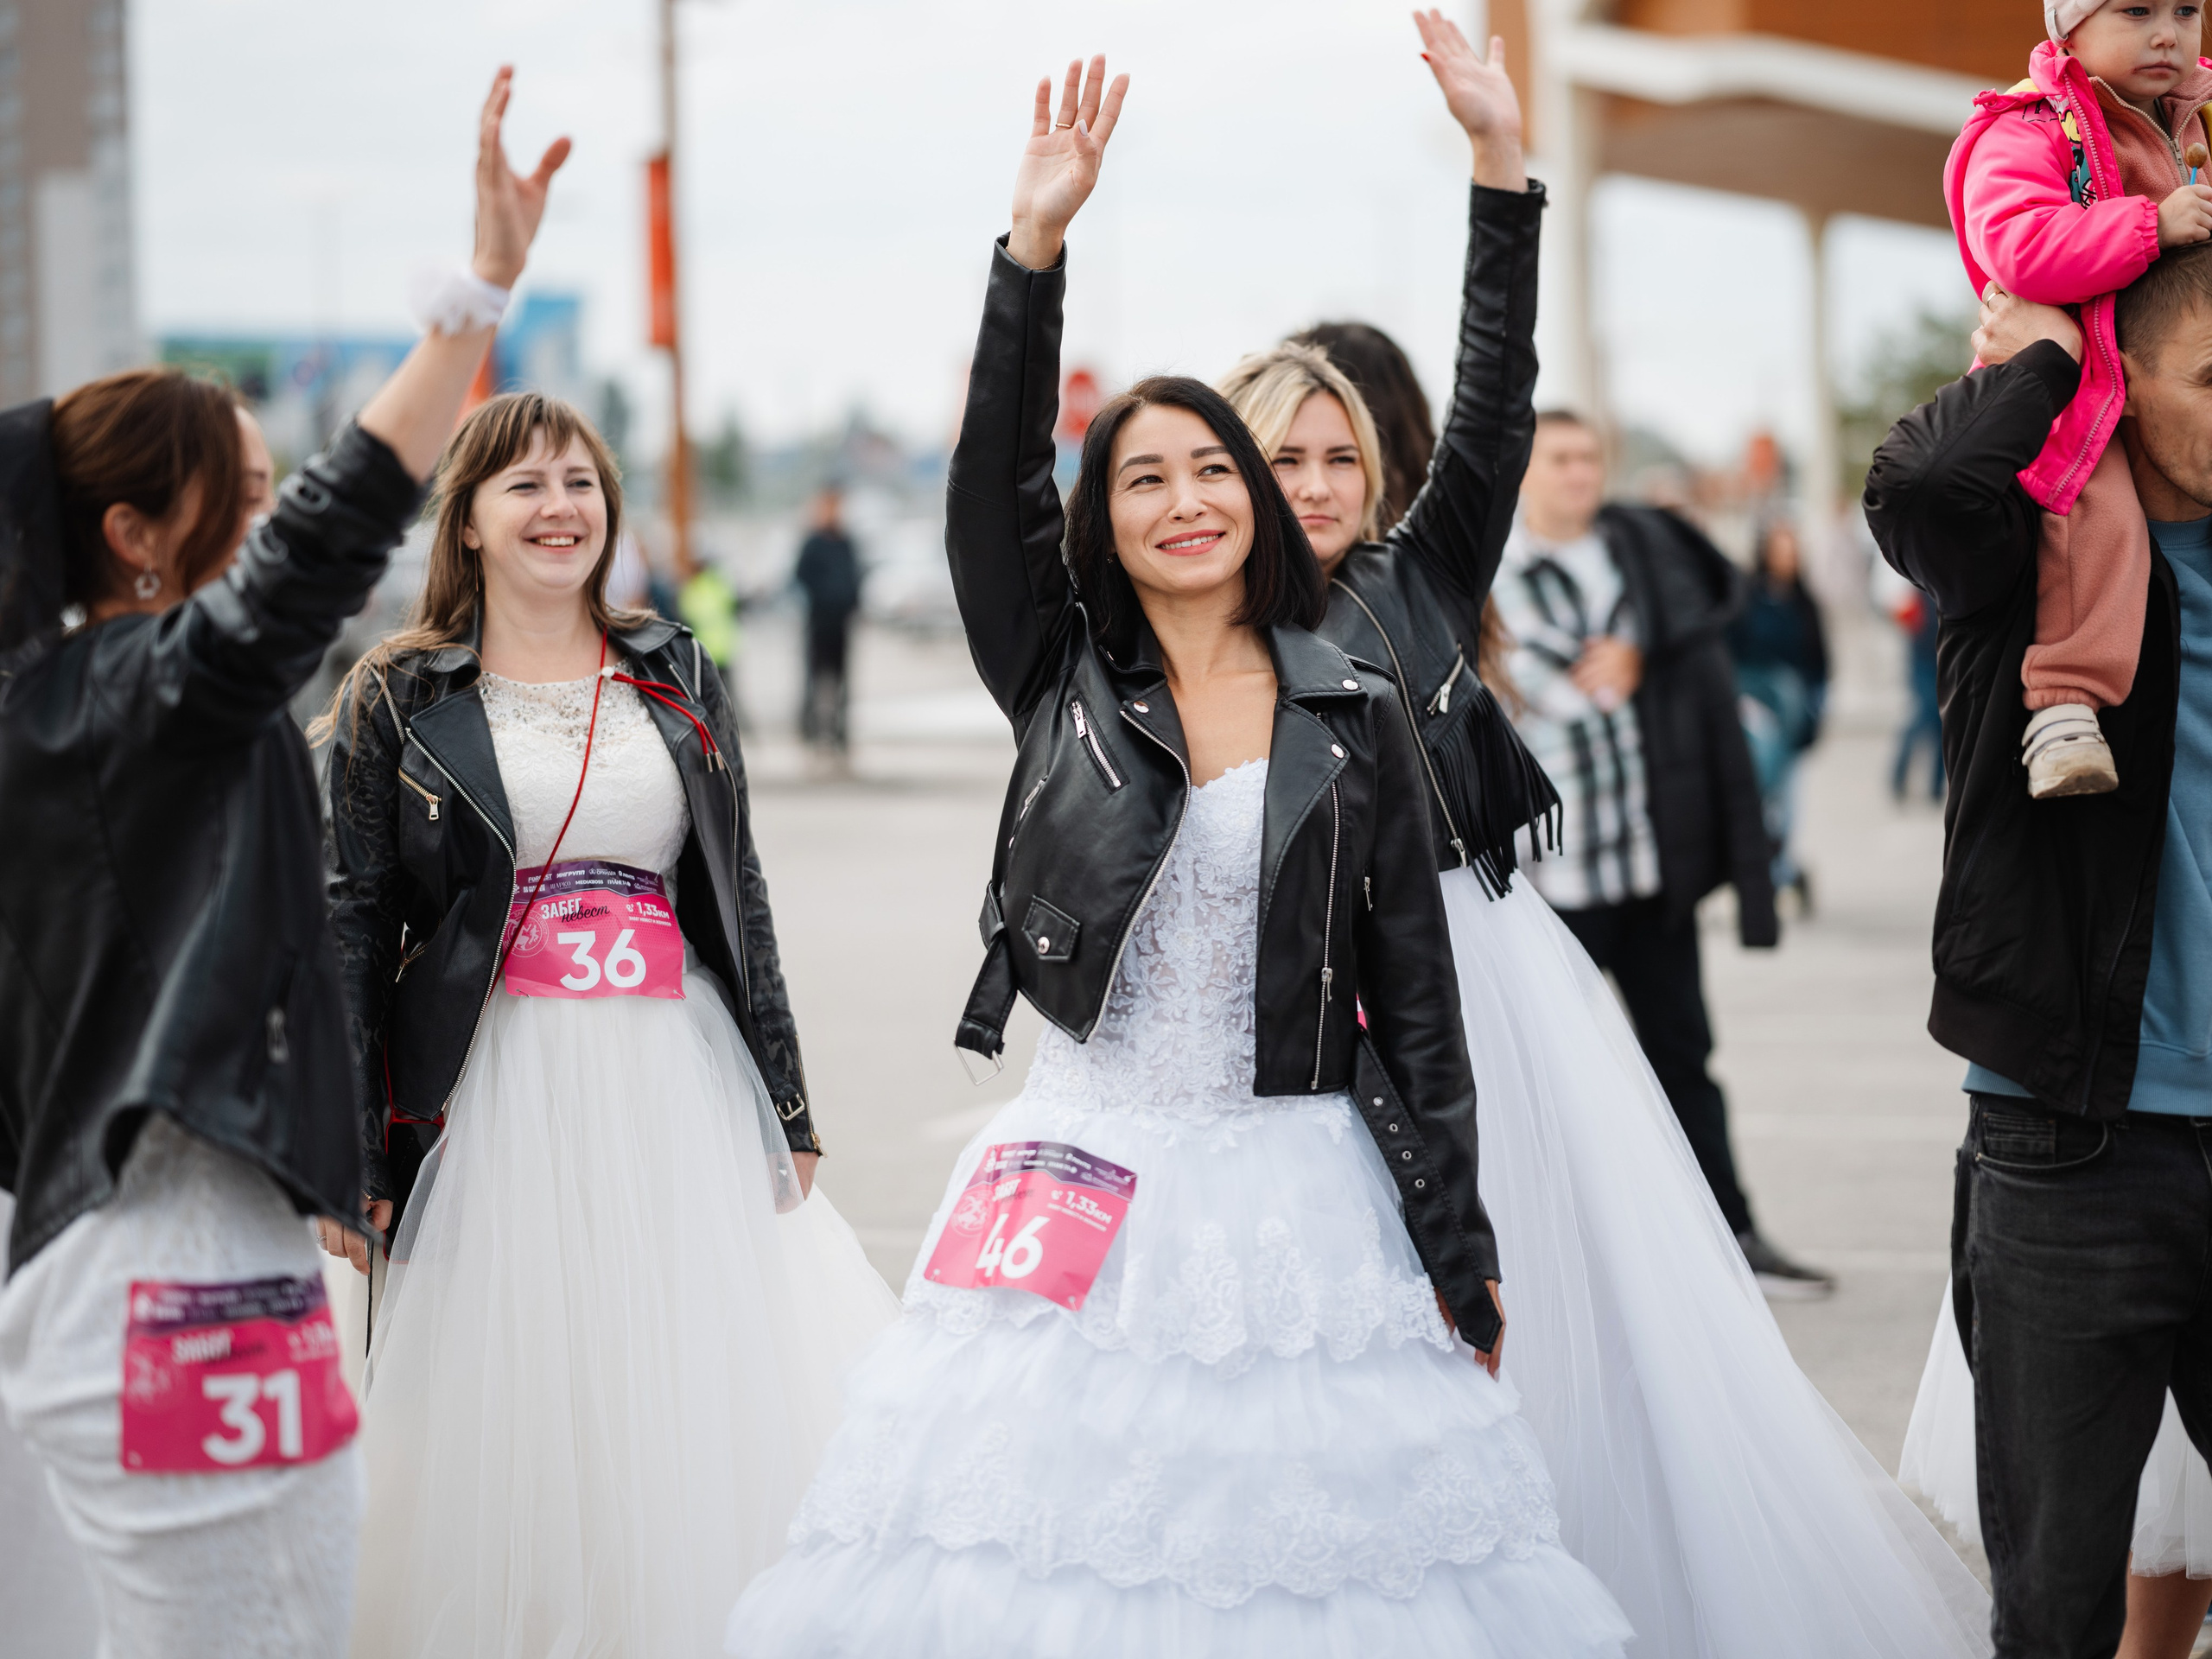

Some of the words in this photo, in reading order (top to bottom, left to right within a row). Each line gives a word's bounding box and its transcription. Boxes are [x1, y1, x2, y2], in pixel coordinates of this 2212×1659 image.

[528, 874, 552, 883] FORST
[541, 898, 582, 919] ЗАБЕГ
[562, 906, 609, 923] невест
[556, 928, 647, 991] 36
[974, 1212, 1051, 1280] 46
[201, 1369, 303, 1465] 31
